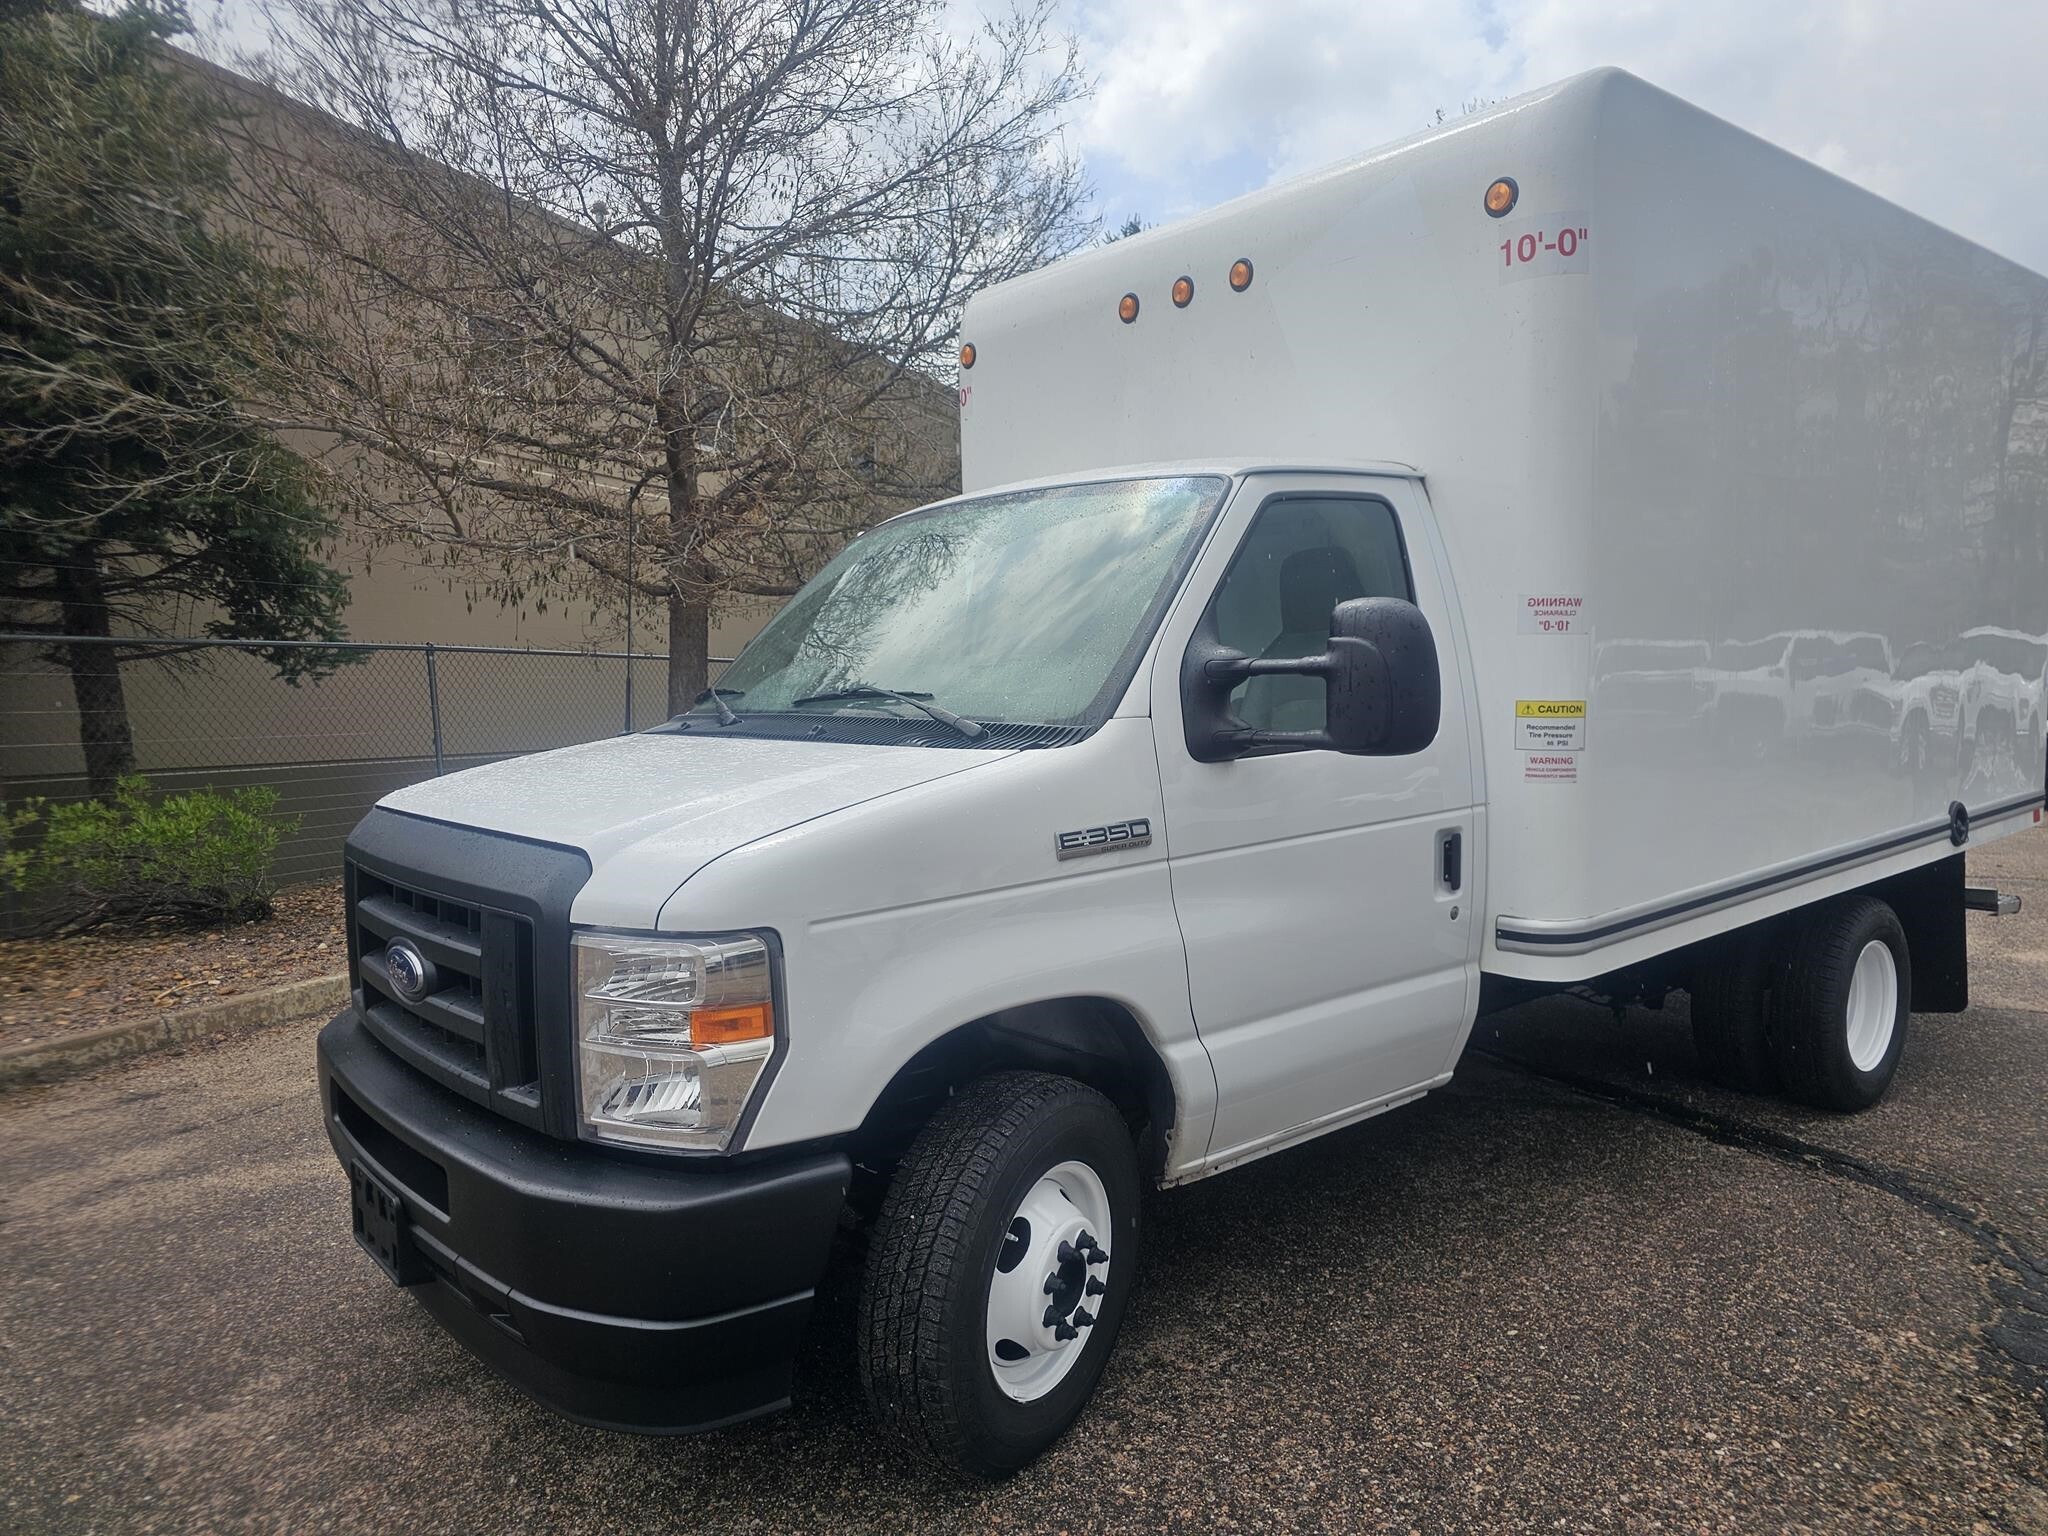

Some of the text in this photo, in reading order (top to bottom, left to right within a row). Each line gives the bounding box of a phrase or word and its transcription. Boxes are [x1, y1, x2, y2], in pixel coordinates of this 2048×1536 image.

[1500, 227, 1588, 267] 10'-0"
[1537, 705, 1583, 714] CAUTION
[1526, 723, 1576, 731] Recommended
[1529, 757, 1574, 765] WARNING
